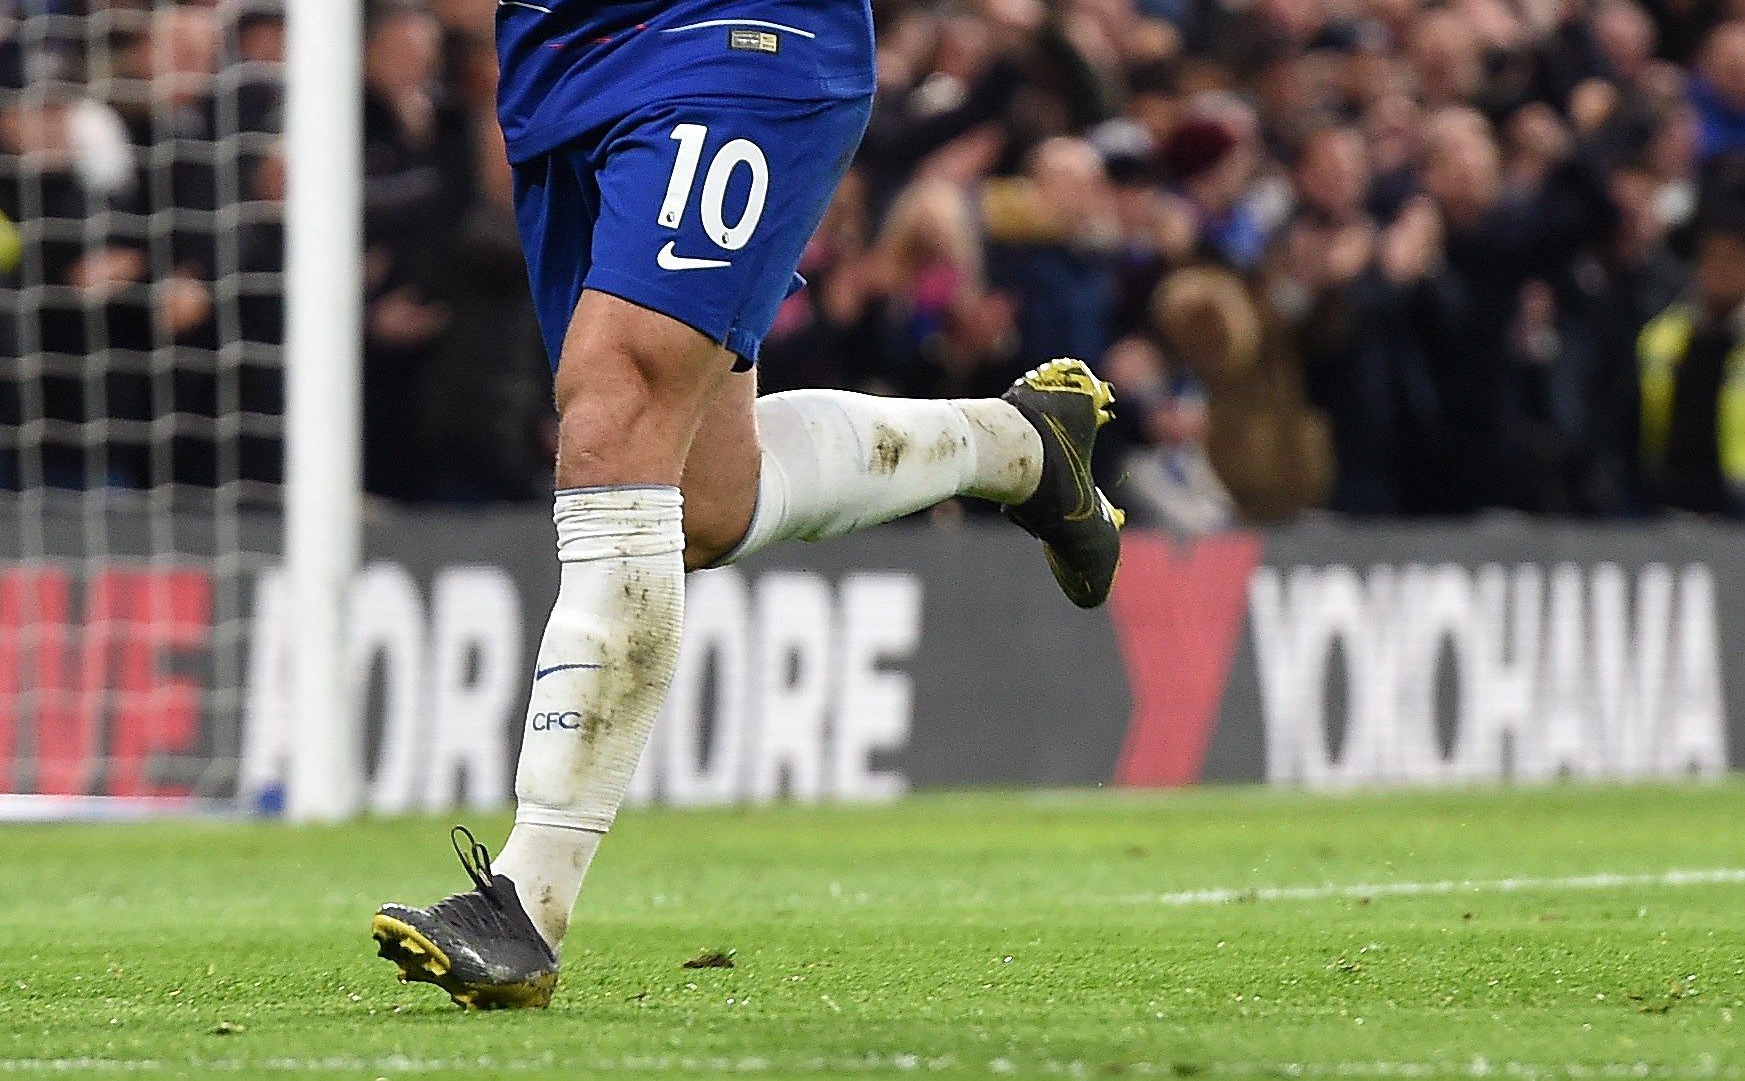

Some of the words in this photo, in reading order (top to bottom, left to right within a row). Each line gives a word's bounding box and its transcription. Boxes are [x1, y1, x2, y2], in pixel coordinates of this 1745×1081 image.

[657, 123, 769, 250] 10
[532, 711, 582, 731] CFC
[626, 567, 923, 804] ORE
[1247, 562, 1731, 788] YOKOHAMA
